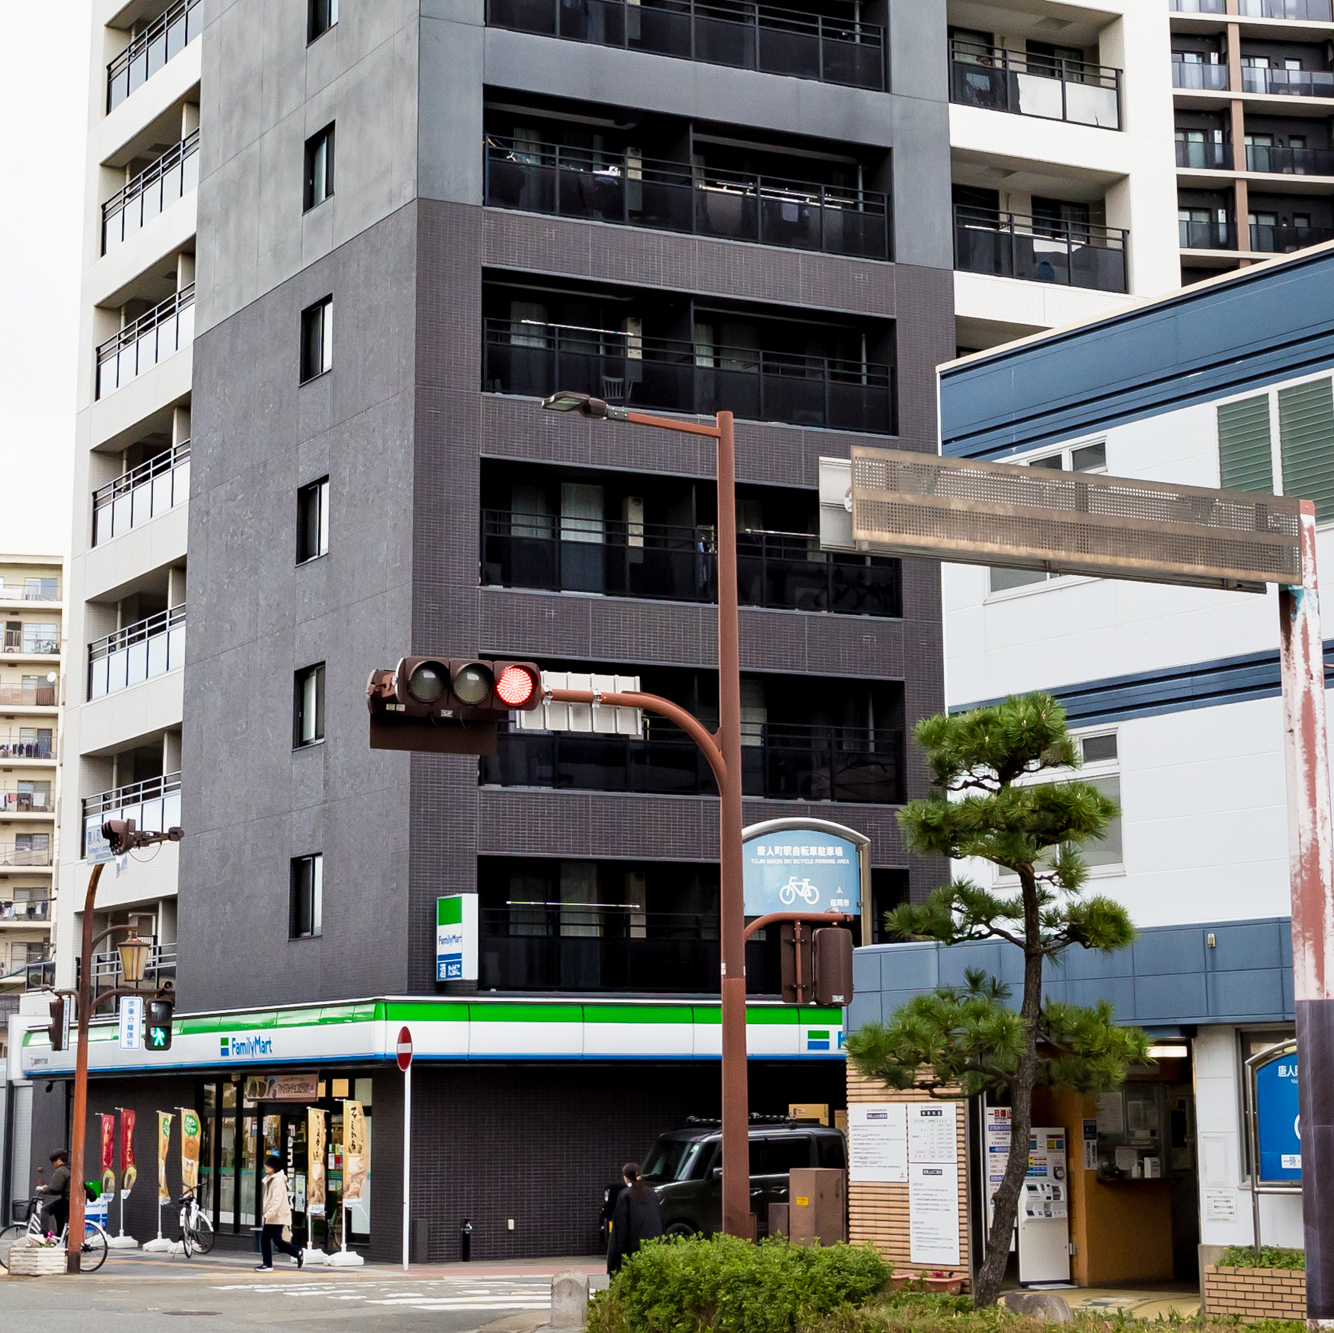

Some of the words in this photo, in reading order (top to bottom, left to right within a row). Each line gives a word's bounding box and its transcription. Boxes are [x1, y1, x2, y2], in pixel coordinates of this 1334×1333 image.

[757, 846, 844, 857] 唐人町駅自転車駐車場
[232, 1036, 273, 1057] FamilyMart
